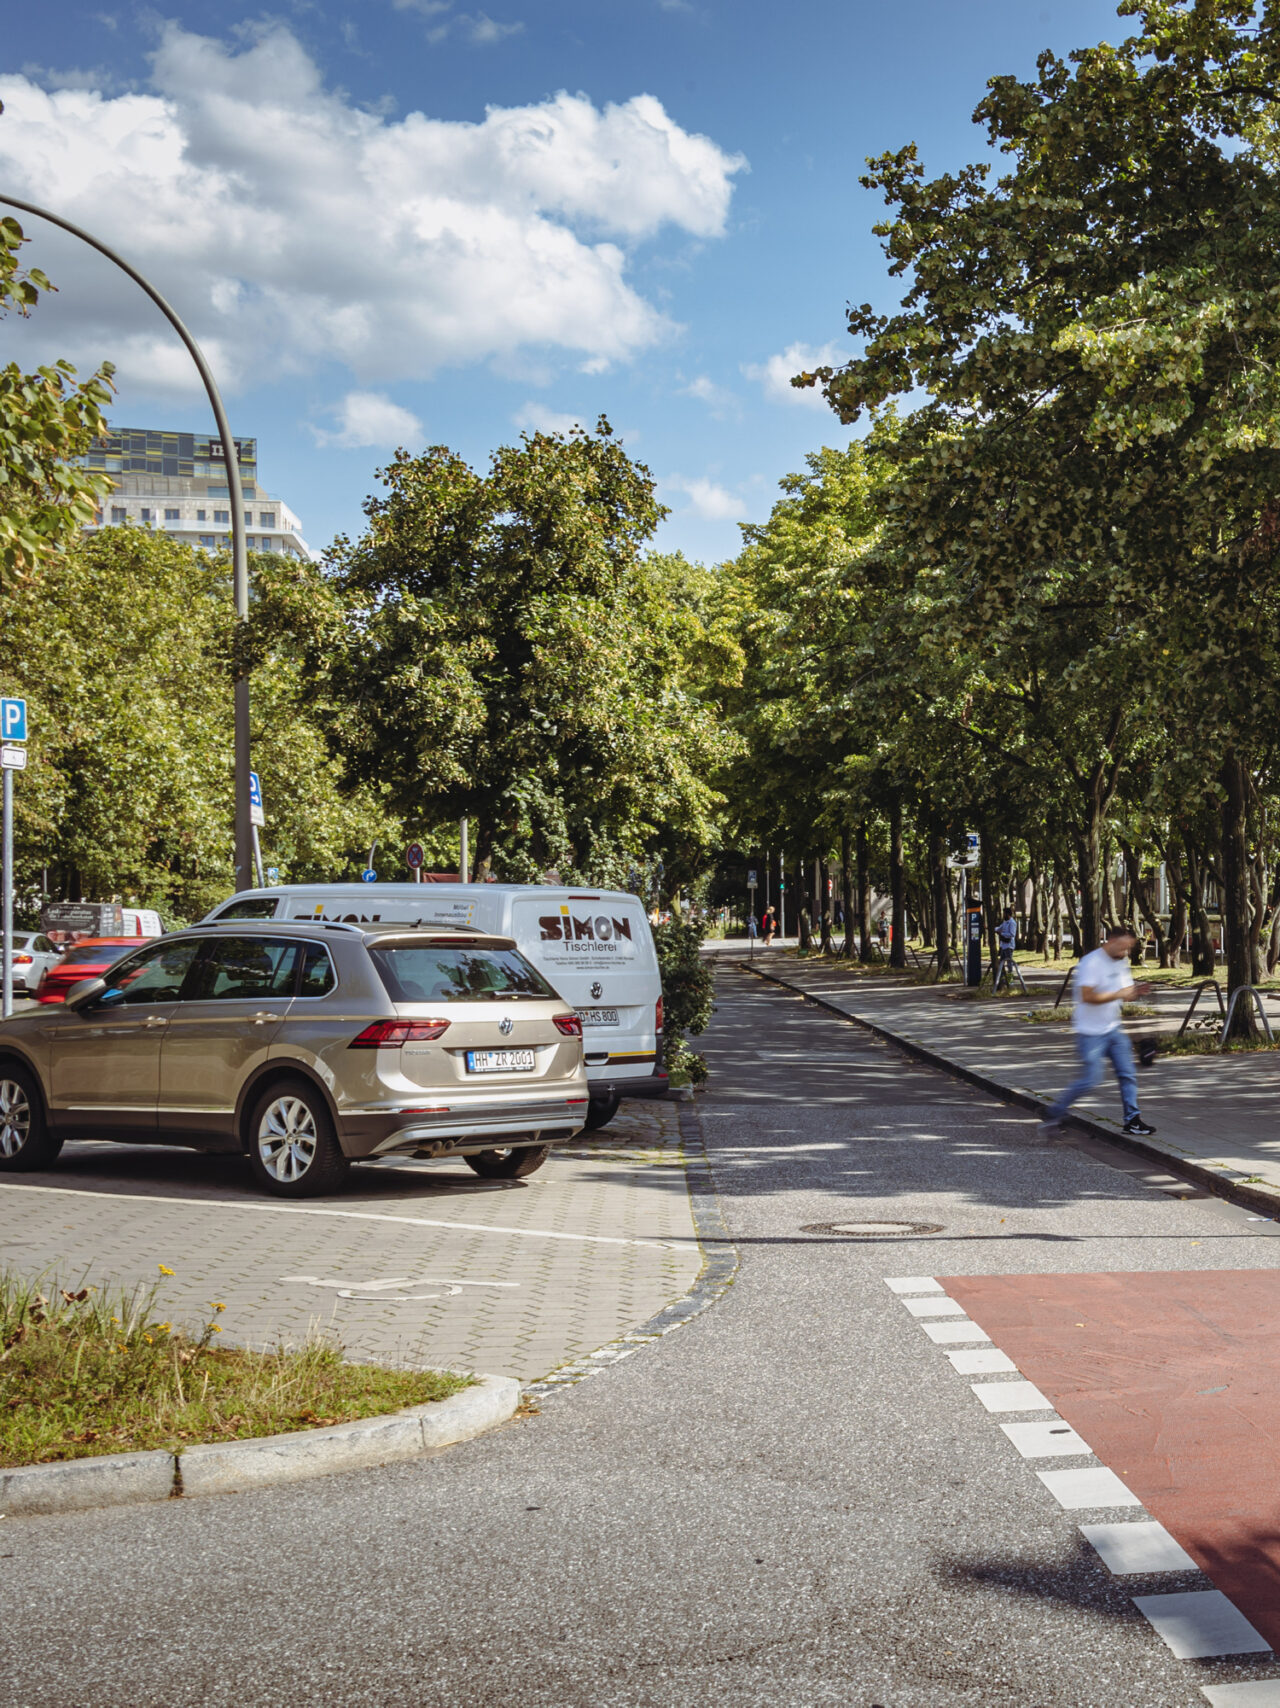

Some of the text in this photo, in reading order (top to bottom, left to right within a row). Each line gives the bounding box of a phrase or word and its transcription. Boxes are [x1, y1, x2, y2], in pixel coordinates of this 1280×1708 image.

[6, 704, 20, 734] P
[563, 941, 617, 952] Tischlerei
[590, 1011, 602, 1022] HS
[602, 1011, 617, 1022] 800
[475, 1050, 533, 1067] HH ZR 2001
